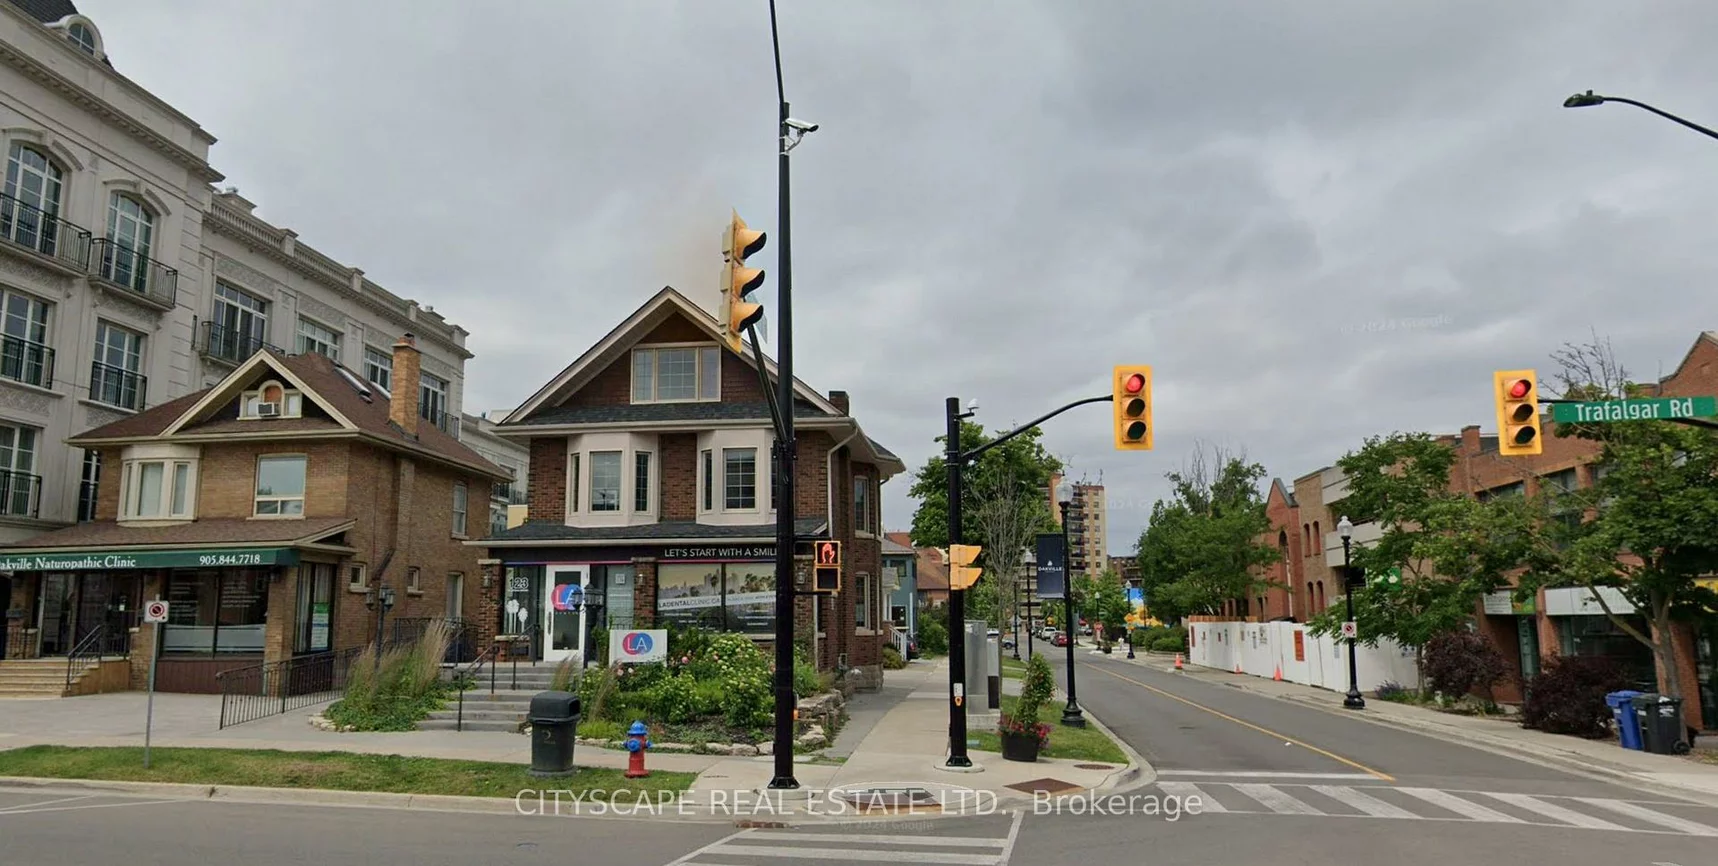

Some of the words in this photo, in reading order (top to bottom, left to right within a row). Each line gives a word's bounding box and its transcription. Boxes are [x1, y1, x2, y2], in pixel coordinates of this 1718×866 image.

[1575, 401, 1660, 421] Trafalgar
[1670, 398, 1694, 417] Rd
[664, 548, 688, 557] LET'S
[689, 548, 717, 557] START
[718, 548, 742, 556] WITH
[744, 548, 752, 556] A
[0, 557, 33, 570] akville
[34, 556, 102, 570] Naturopathic
[104, 555, 136, 568] Clinic
[199, 554, 261, 565] 905.844.7718
[509, 576, 529, 589] 123
[627, 636, 648, 650] LA
